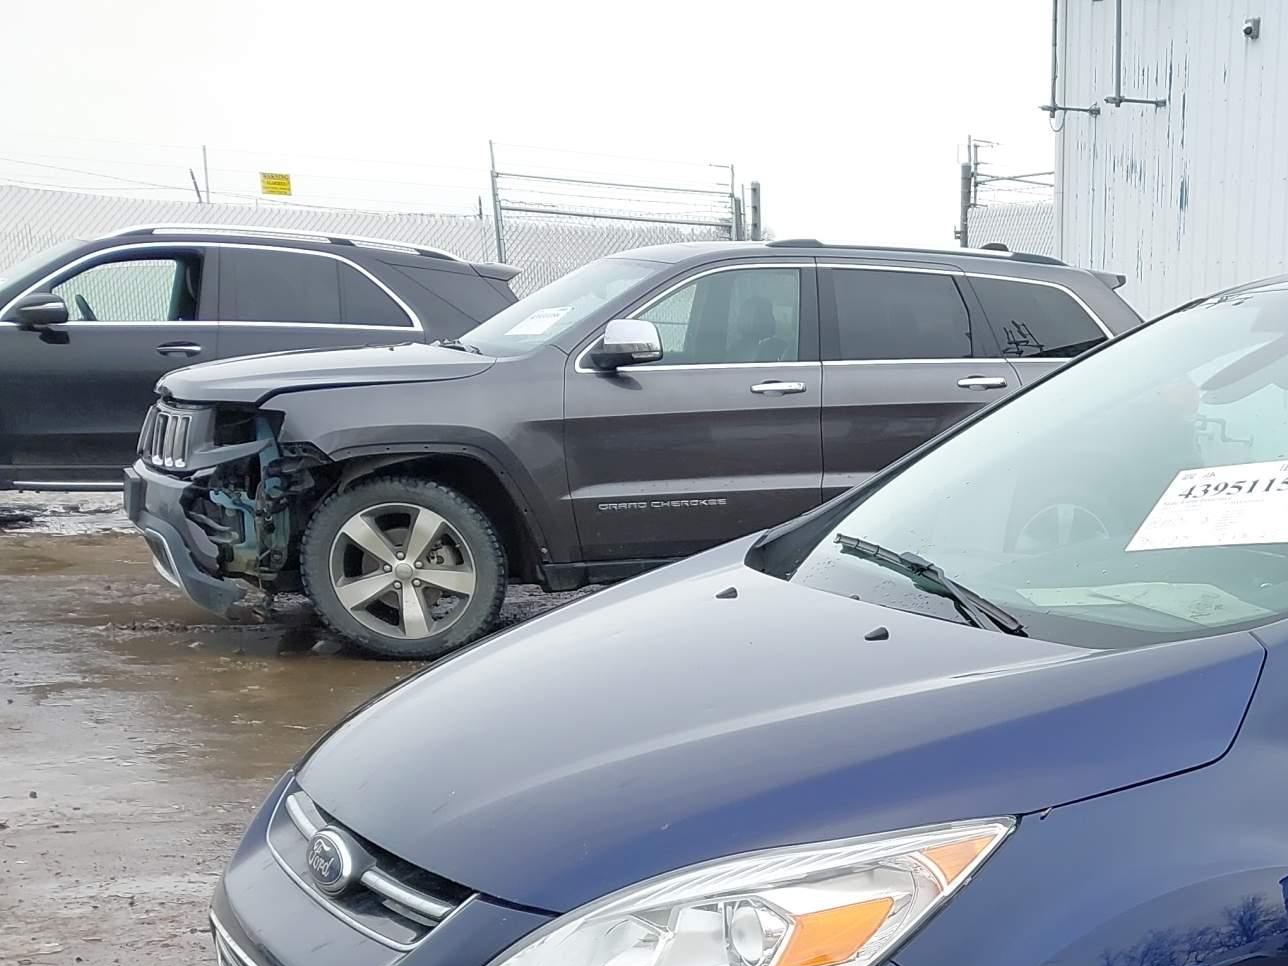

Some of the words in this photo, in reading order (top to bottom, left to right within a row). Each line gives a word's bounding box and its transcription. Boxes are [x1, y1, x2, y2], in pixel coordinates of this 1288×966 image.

[598, 501, 648, 511] GRAND
[650, 497, 728, 509] CHEROKEE
[308, 838, 335, 878] Ford
